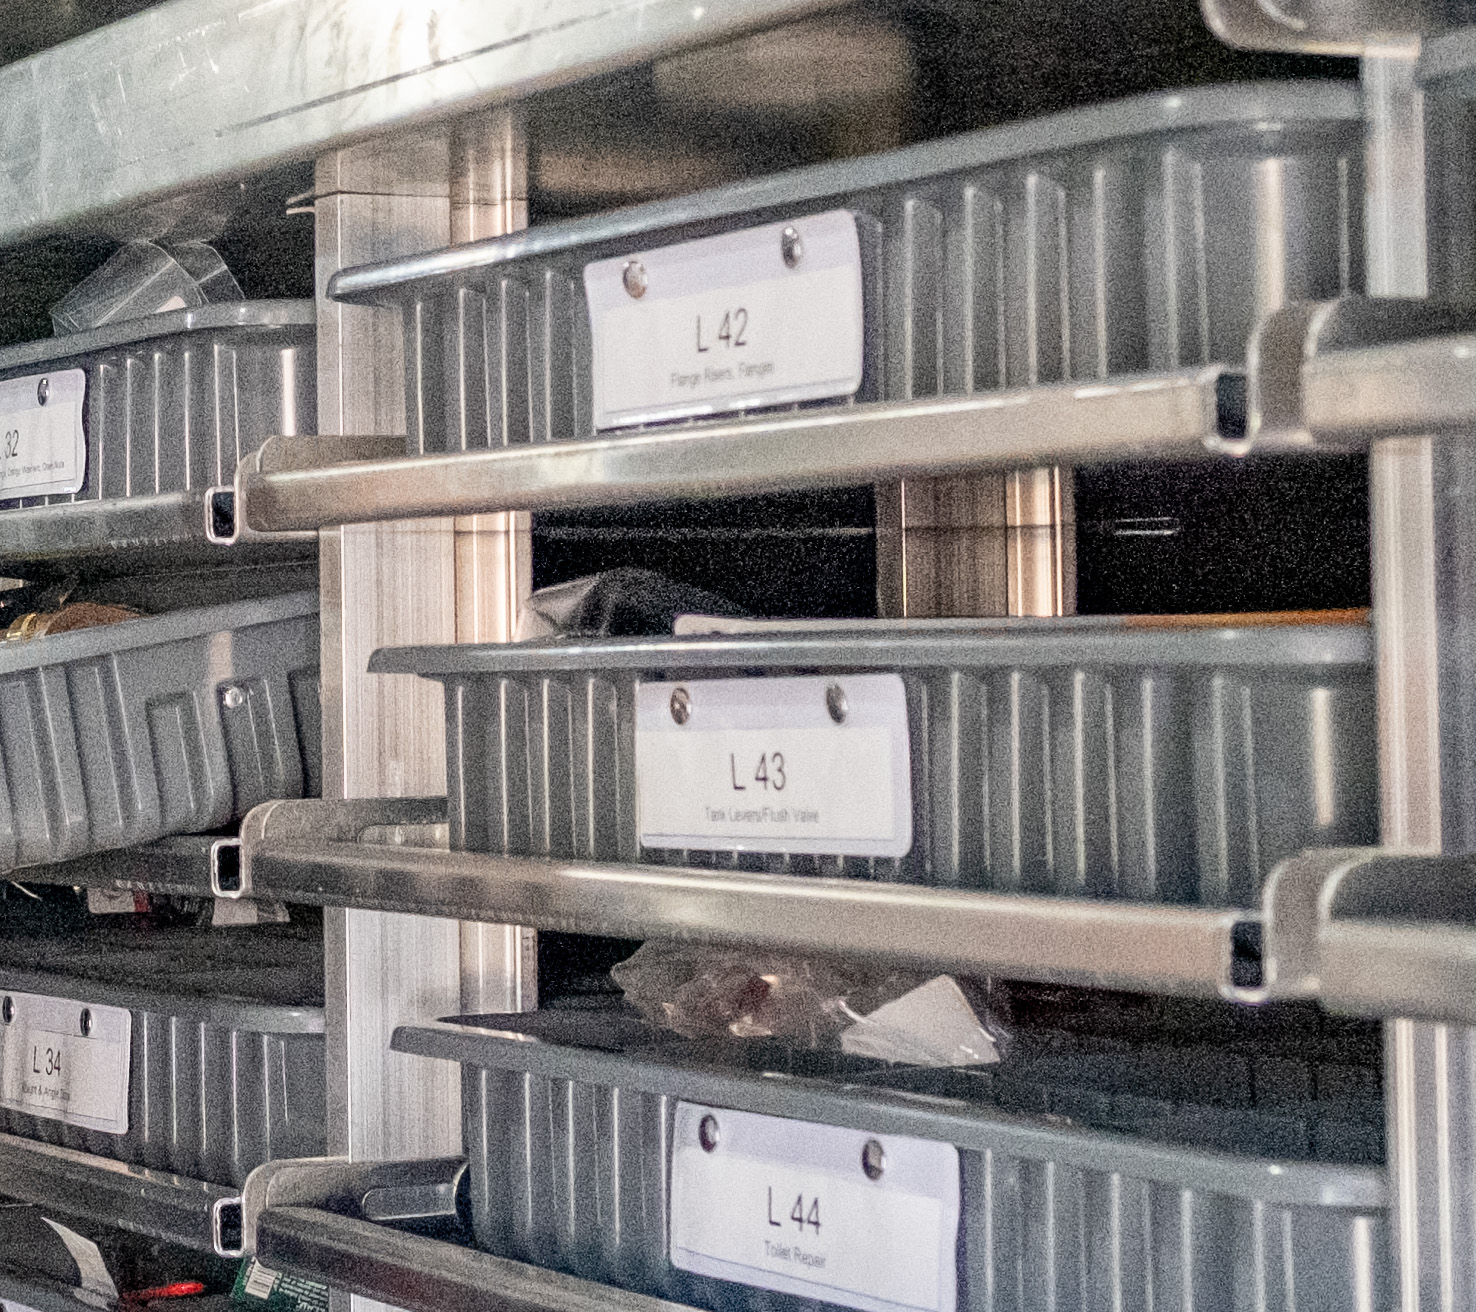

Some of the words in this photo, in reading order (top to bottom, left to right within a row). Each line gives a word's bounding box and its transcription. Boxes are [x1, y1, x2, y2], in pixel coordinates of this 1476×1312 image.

[697, 314, 709, 353] L
[718, 307, 749, 348] 42
[5, 429, 19, 459] 32
[731, 752, 747, 791] L
[754, 751, 787, 791] 43
[33, 1045, 41, 1074] L
[45, 1047, 61, 1077] 34
[768, 1185, 782, 1228] L
[790, 1193, 822, 1236] 44
